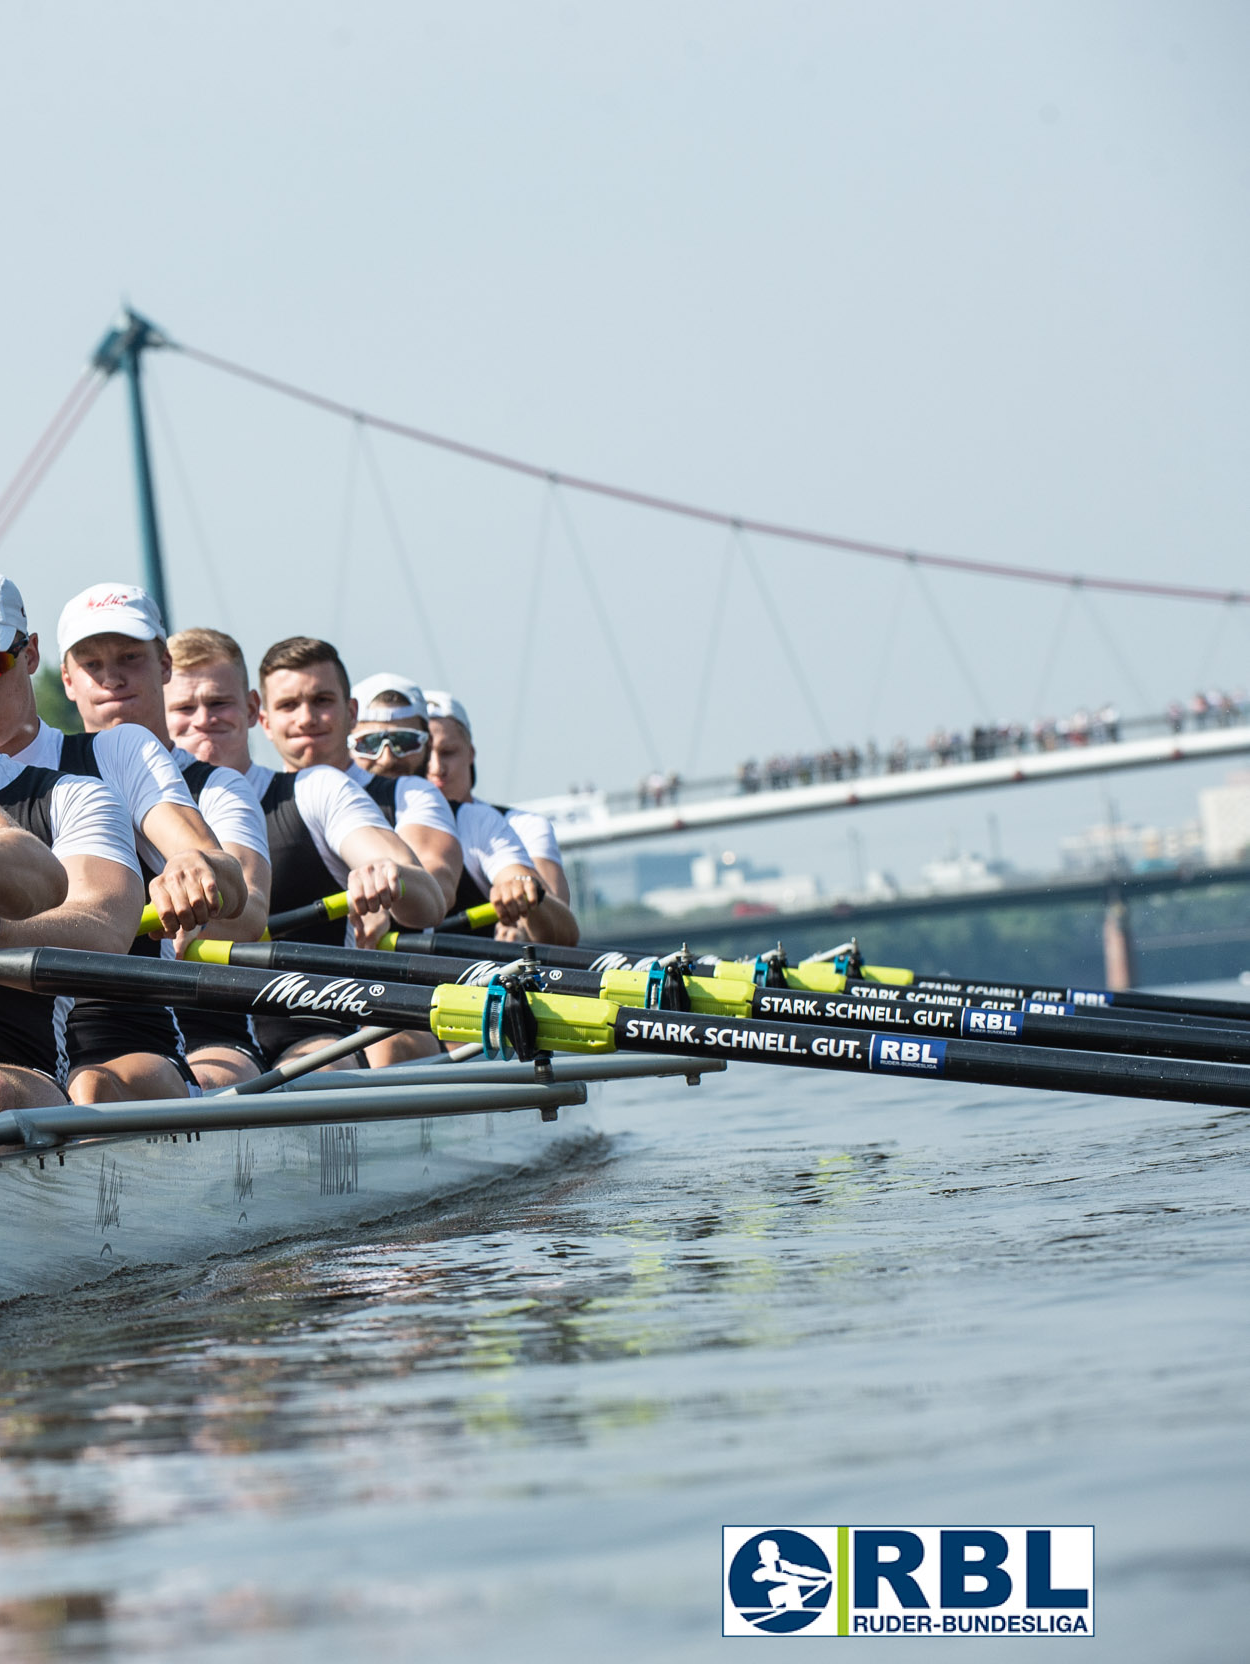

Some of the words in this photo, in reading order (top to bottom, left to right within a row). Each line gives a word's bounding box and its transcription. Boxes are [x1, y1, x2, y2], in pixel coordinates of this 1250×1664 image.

[760, 996, 822, 1017] STARK.
[824, 1002, 910, 1025] SCHNELL.
[913, 1010, 955, 1029] GUT.
[969, 1012, 1017, 1031] RBL
[626, 1020, 700, 1044] STARK.
[704, 1027, 807, 1055] SCHNELL.
[811, 1037, 863, 1060] GUT.
[880, 1039, 938, 1064] RBL
